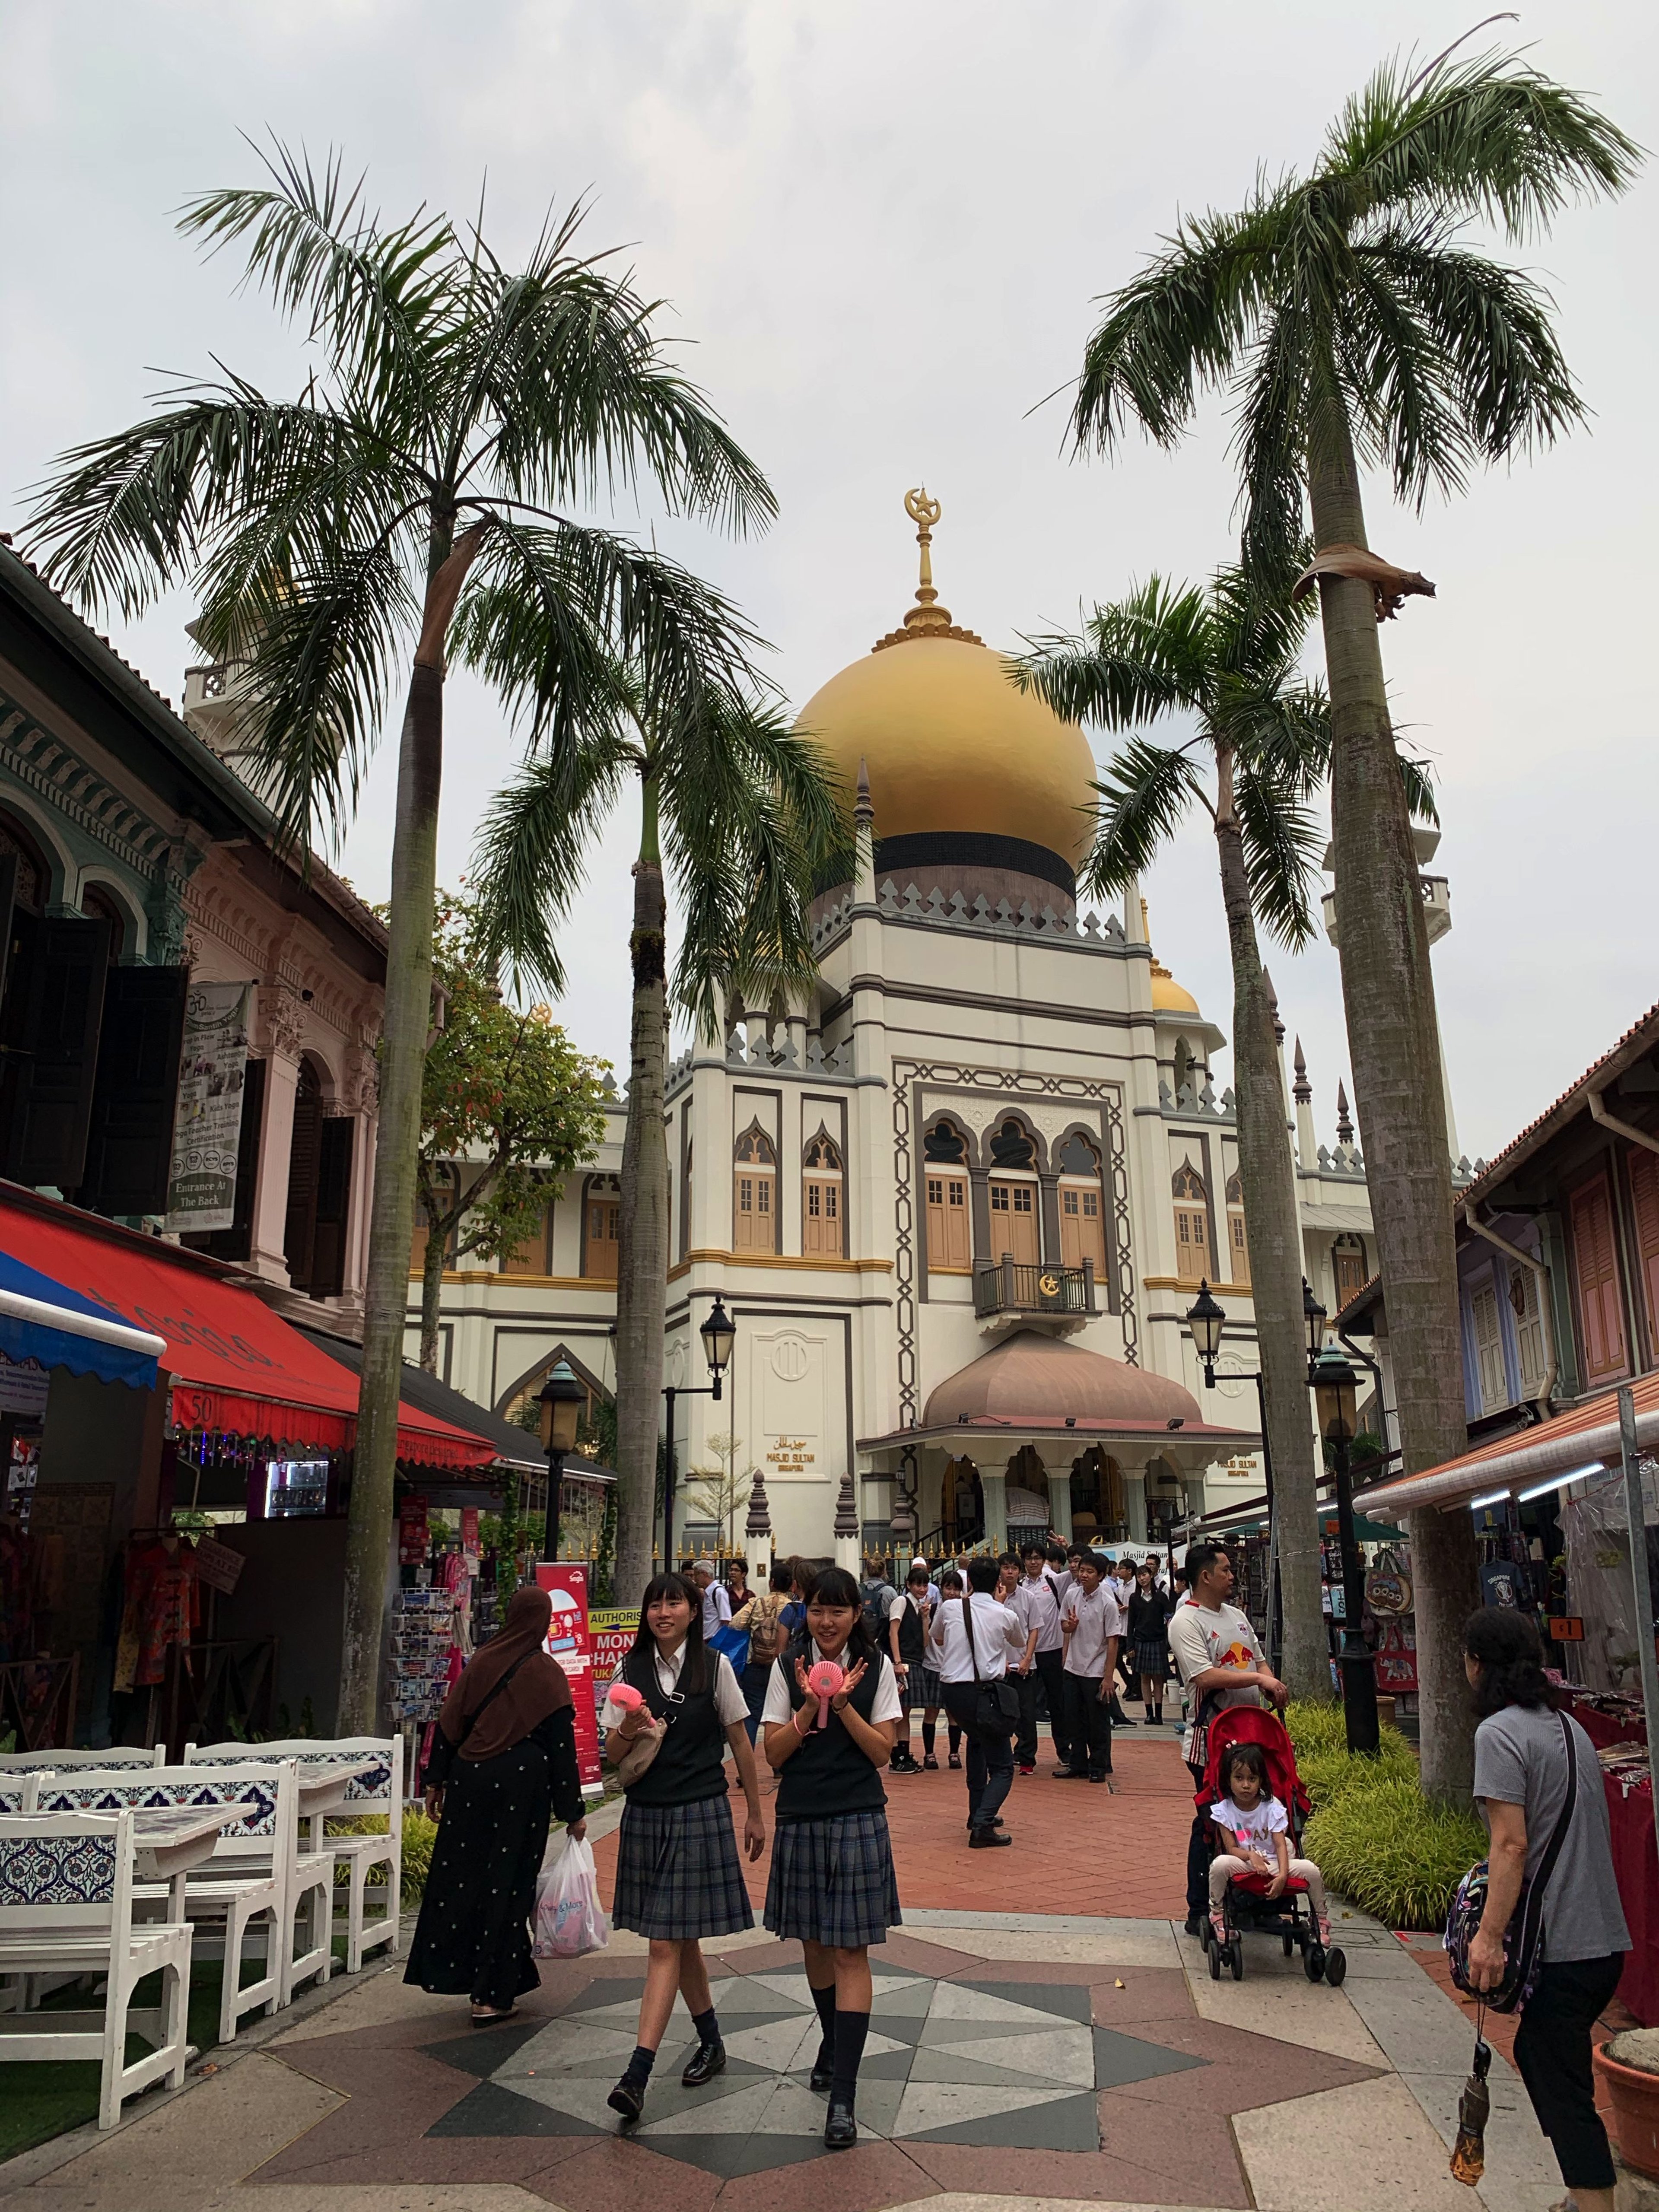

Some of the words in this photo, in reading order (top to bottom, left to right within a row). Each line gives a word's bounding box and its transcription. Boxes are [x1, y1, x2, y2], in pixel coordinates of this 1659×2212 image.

[222, 1007, 239, 1023] Yoga
[181, 1079, 202, 1090] renatal
[183, 1091, 197, 1100] Yoga
[224, 1102, 239, 1110] Yoga
[175, 1130, 187, 1139] oga
[188, 1125, 213, 1135] Teacher
[214, 1119, 239, 1130] Training
[187, 1132, 225, 1146] Certification
[175, 1182, 215, 1193] Entrance
[216, 1180, 226, 1190] At
[181, 1197, 196, 1207] The
[198, 1195, 219, 1206] Back
[191, 1395, 213, 1423] 50
[766, 1453, 789, 1462] MASJID
[792, 1453, 814, 1463] SULTAN
[1239, 1460, 1257, 1468] SULTAN
[1122, 1550, 1145, 1561] Masjid
[1487, 1574, 1511, 1585] SINGAPORE
[1559, 1620, 1572, 1636] $1
[596, 1634, 637, 1649] MON
[566, 1901, 583, 1911] More
